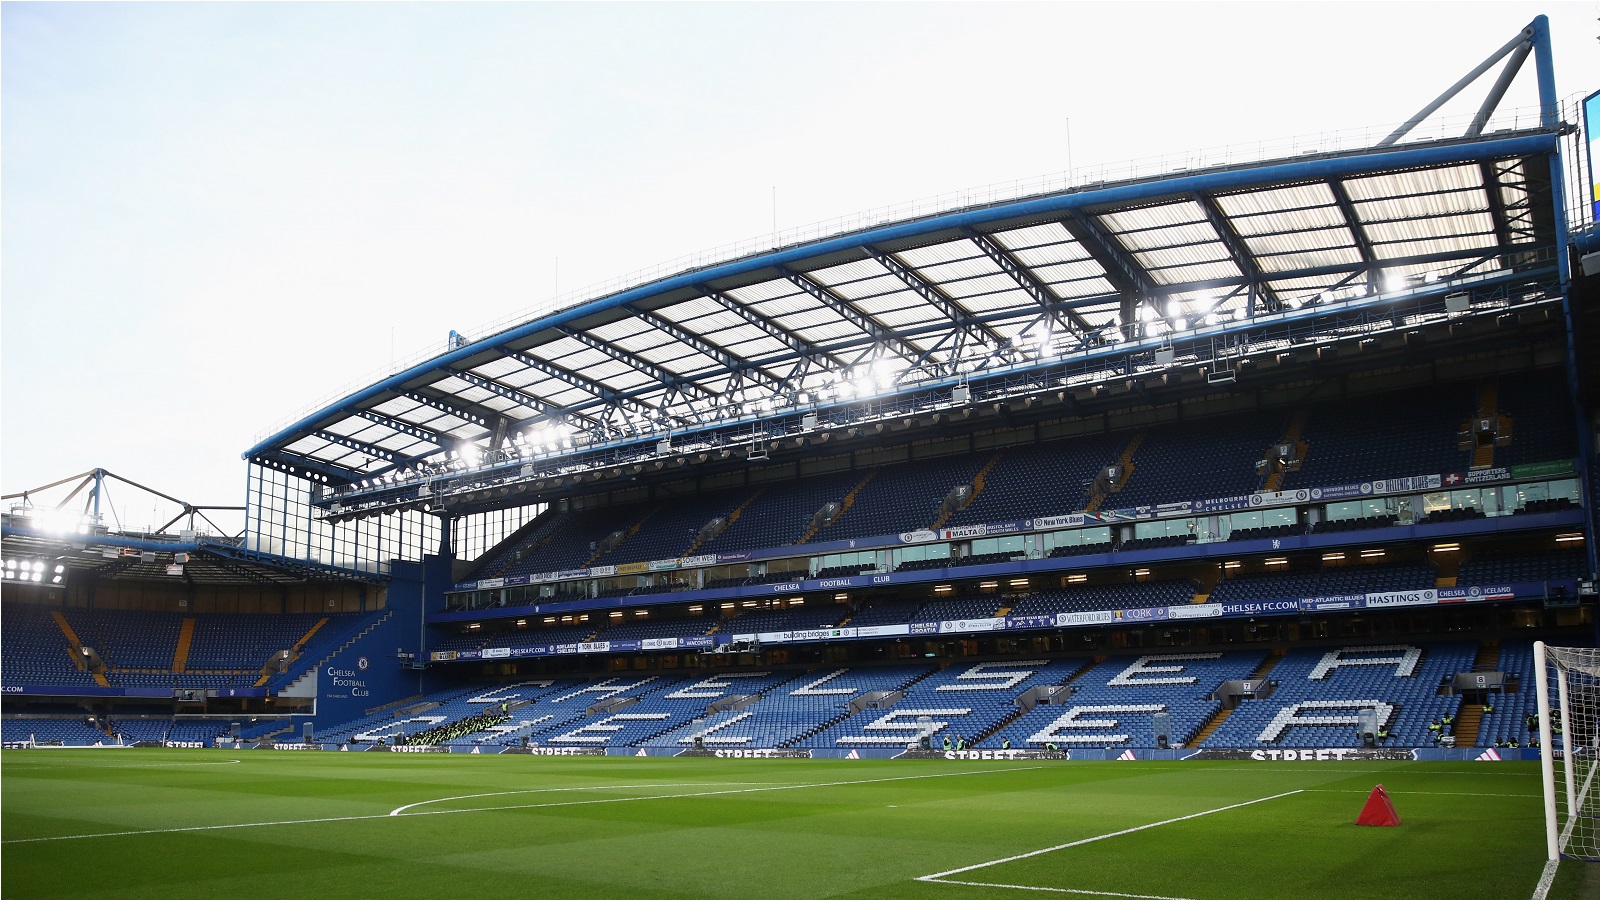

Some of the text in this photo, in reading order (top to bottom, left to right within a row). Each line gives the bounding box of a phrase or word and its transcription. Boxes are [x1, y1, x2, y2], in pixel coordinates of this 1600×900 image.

[1468, 468, 1506, 477] SUPPORTERS
[1465, 473, 1510, 483] SWITZERLAND
[1385, 478, 1410, 492] HELLENIC
[1411, 476, 1429, 489] BLUES
[1205, 496, 1248, 505] MELBOURNE
[1205, 503, 1248, 512] CHELSEA
[1043, 516, 1084, 527] New York Blues
[774, 584, 800, 592] CHELSEA
[820, 579, 851, 587] FOOTBALL
[1439, 586, 1511, 597] CHELSEA ICELAND
[1301, 596, 1344, 604] MID-ATLANTIC
[1369, 594, 1420, 604] HASTINGS
[1222, 604, 1262, 613] CHELSEA
[1263, 601, 1298, 610] FC.COM
[1066, 612, 1111, 624] WATERFORD BLUES
[1126, 608, 1152, 618] CORK
[807, 629, 830, 639] bridges
[327, 666, 356, 677] CHELSEA
[333, 677, 366, 687] FOOTBALL
[351, 687, 370, 697] CLUB
[1251, 750, 1346, 761] STREET
